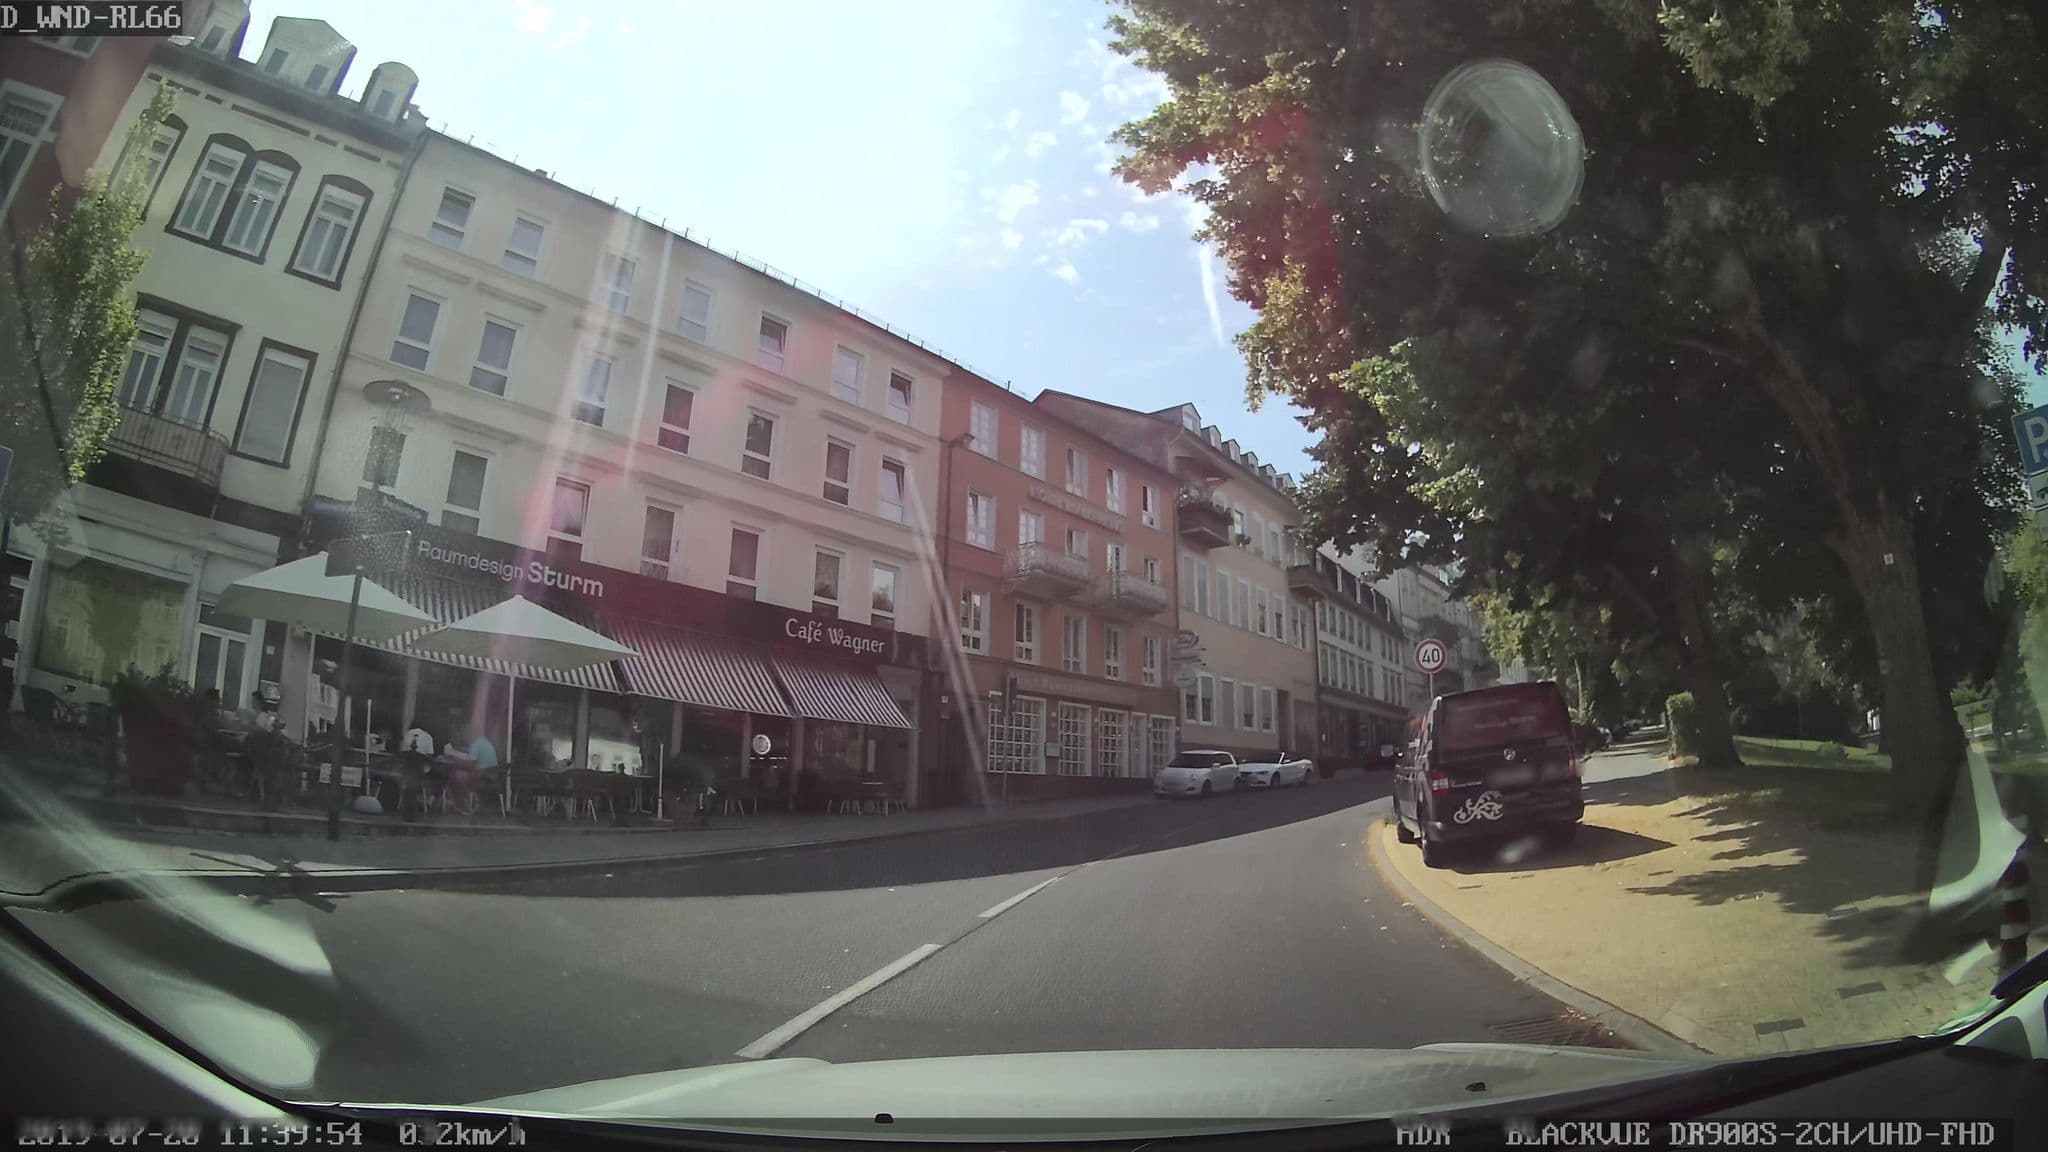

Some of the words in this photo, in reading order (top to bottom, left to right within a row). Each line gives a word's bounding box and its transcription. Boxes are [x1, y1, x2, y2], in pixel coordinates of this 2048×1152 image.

[2024, 416, 2048, 463] P
[418, 539, 524, 582] Raumdesign
[527, 561, 604, 598] Sturm
[785, 617, 823, 644] Café
[828, 627, 885, 655] Wagner
[1421, 647, 1440, 663] 40
